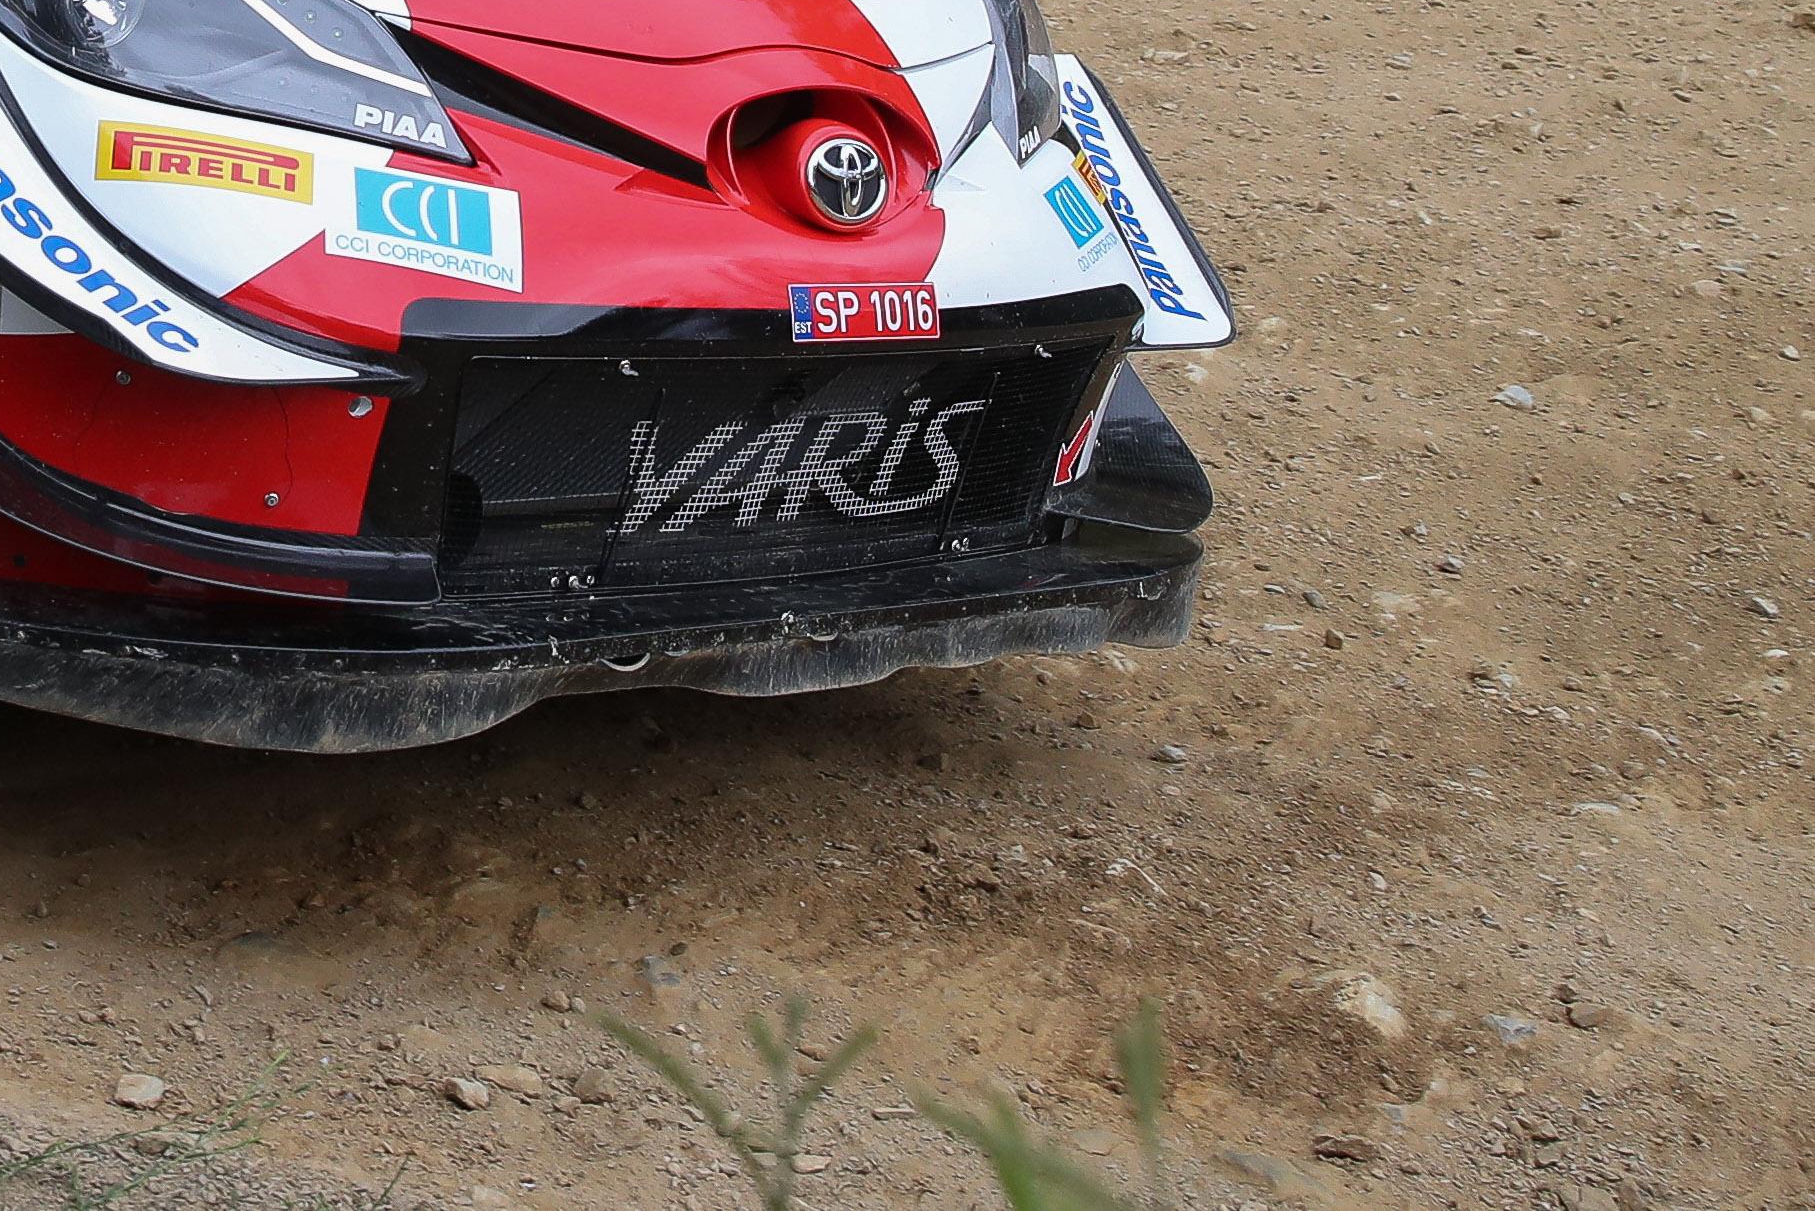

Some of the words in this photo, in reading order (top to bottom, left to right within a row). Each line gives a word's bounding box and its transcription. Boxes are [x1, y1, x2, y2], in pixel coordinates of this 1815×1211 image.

[353, 102, 447, 149] PIAA
[1019, 126, 1041, 159] PIAA
[112, 130, 301, 194] PIRELLI
[382, 178, 461, 246] CCI
[1063, 81, 1209, 322] Panasonic
[334, 233, 374, 259] CCI
[376, 240, 515, 285] CORPORATION
[794, 321, 812, 334] EST
[815, 291, 860, 333] SP
[870, 290, 933, 332] 1016
